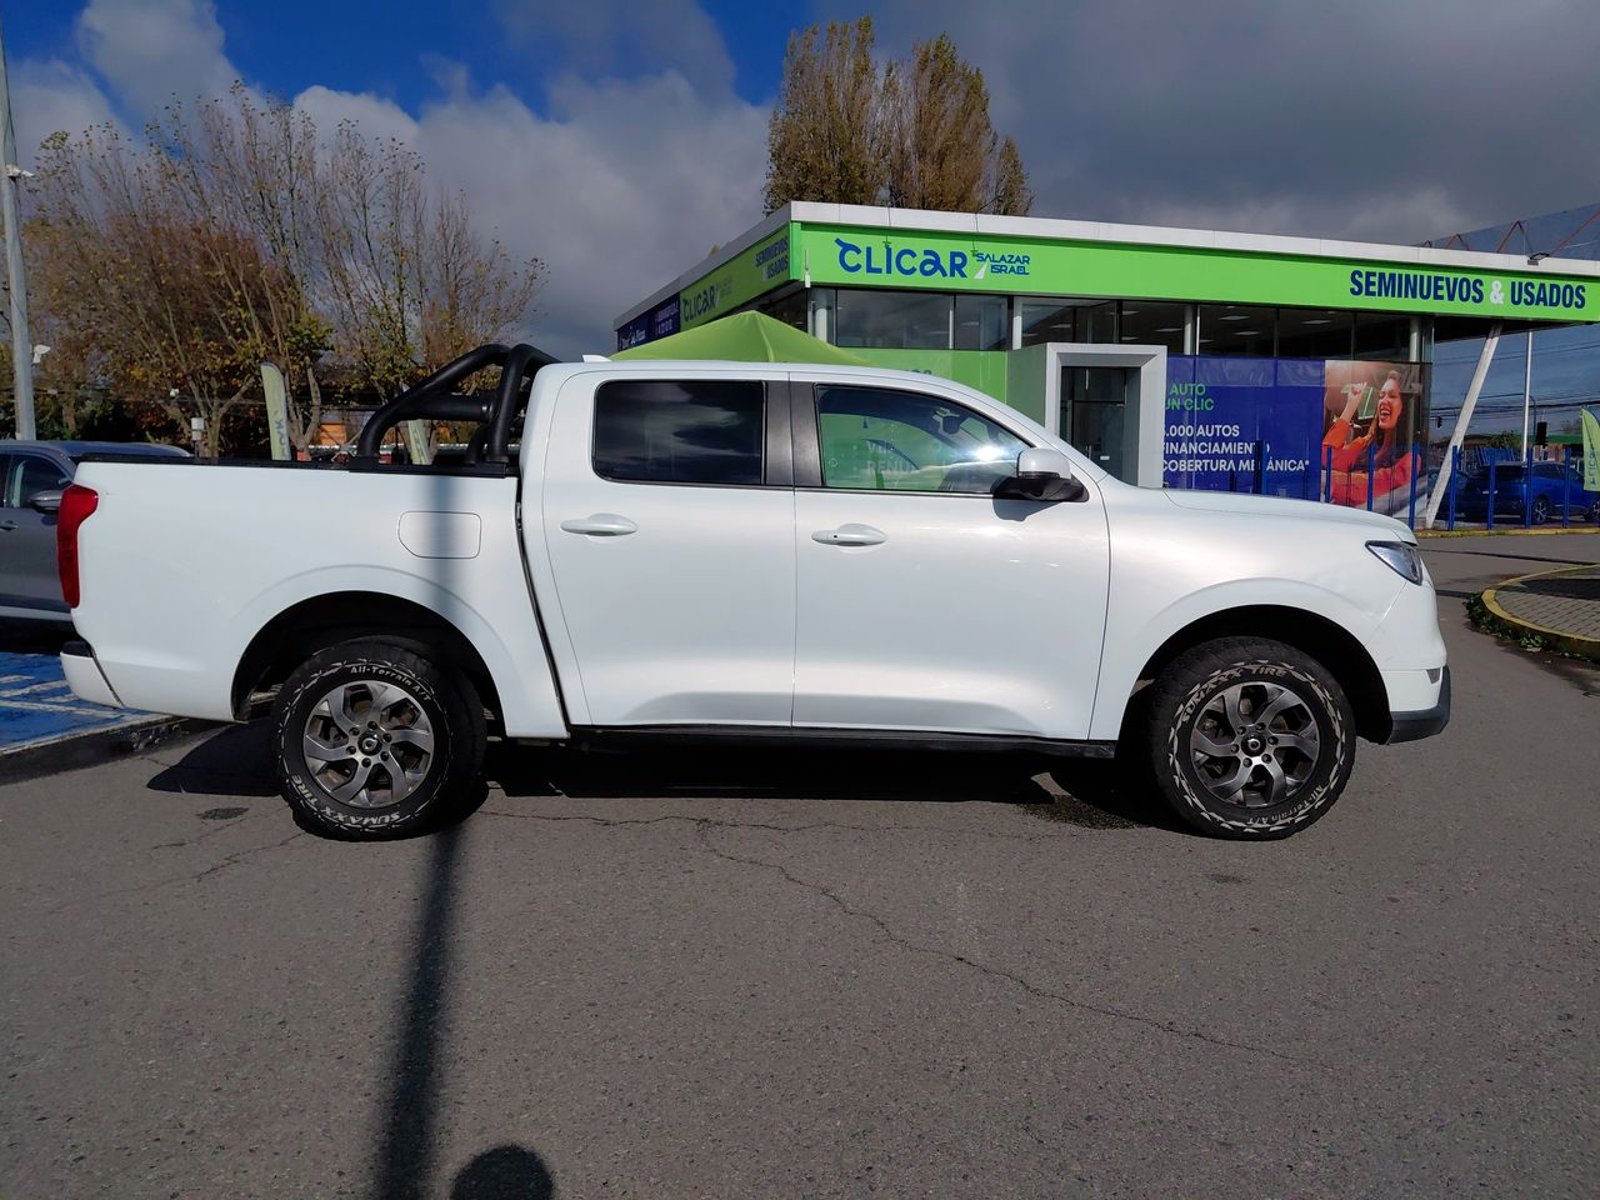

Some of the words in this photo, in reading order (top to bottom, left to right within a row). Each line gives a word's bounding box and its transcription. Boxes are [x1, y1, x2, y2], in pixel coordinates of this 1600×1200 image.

[976, 252, 1030, 265] SALAZAR
[990, 265, 1030, 275] ISRAEL
[1350, 269, 1484, 304] SEMINUEVOS
[1489, 280, 1504, 305] &
[1510, 281, 1586, 309] USADOS
[1170, 383, 1206, 396] AUTO
[1184, 398, 1215, 411] CLIC
[1196, 424, 1240, 437] AUTOS
[1251, 666, 1287, 677] TIRE
[412, 685, 432, 701] A/T
[291, 775, 318, 806] TIRE
